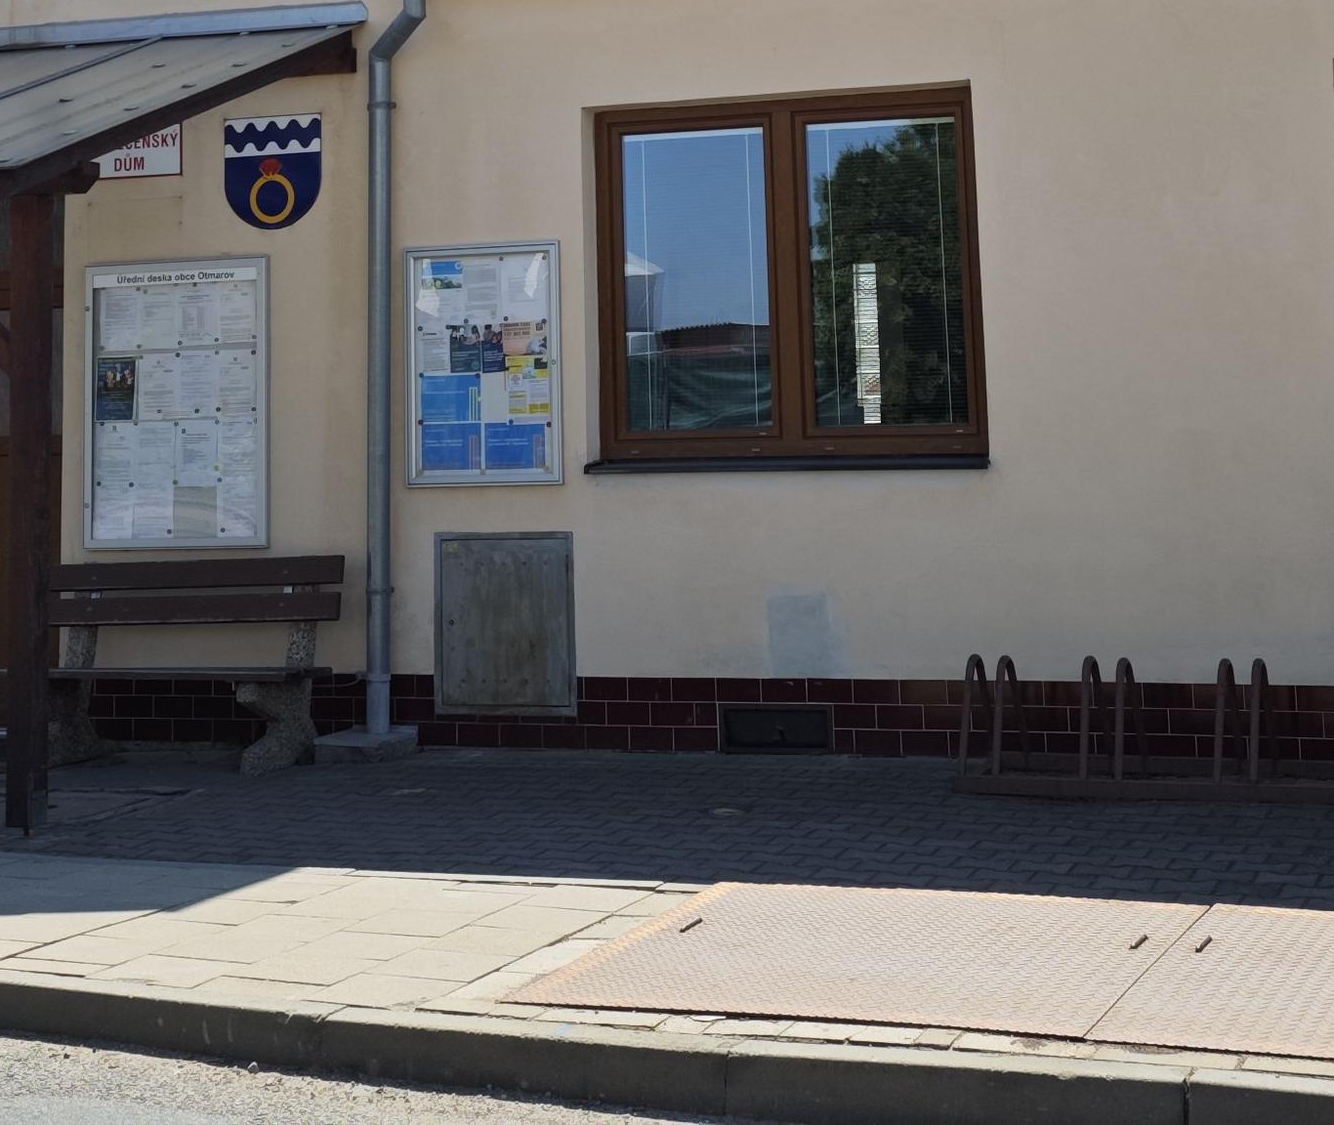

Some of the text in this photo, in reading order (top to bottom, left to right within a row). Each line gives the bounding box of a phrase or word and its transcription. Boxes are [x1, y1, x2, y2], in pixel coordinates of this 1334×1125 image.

[117, 271, 235, 284] Úřední deska obce Otmarov
